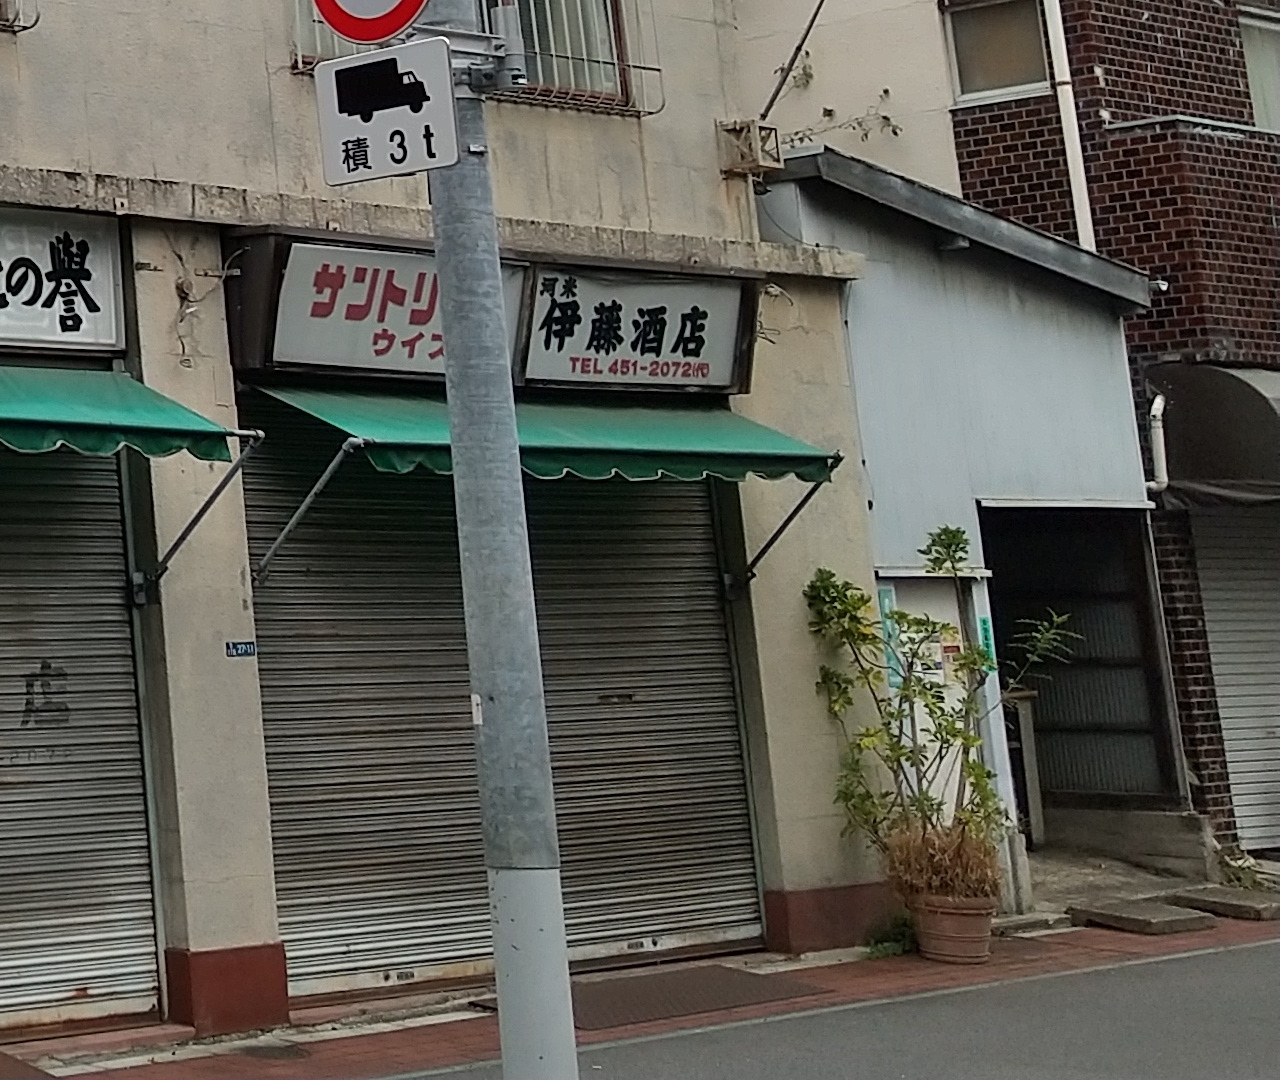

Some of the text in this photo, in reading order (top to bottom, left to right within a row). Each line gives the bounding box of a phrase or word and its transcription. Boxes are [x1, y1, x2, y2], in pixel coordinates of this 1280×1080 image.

[310, 263, 439, 326] サントリ
[372, 328, 445, 360] ウイス
[538, 298, 709, 358] 伊藤酒店
[569, 356, 603, 374] TEL
